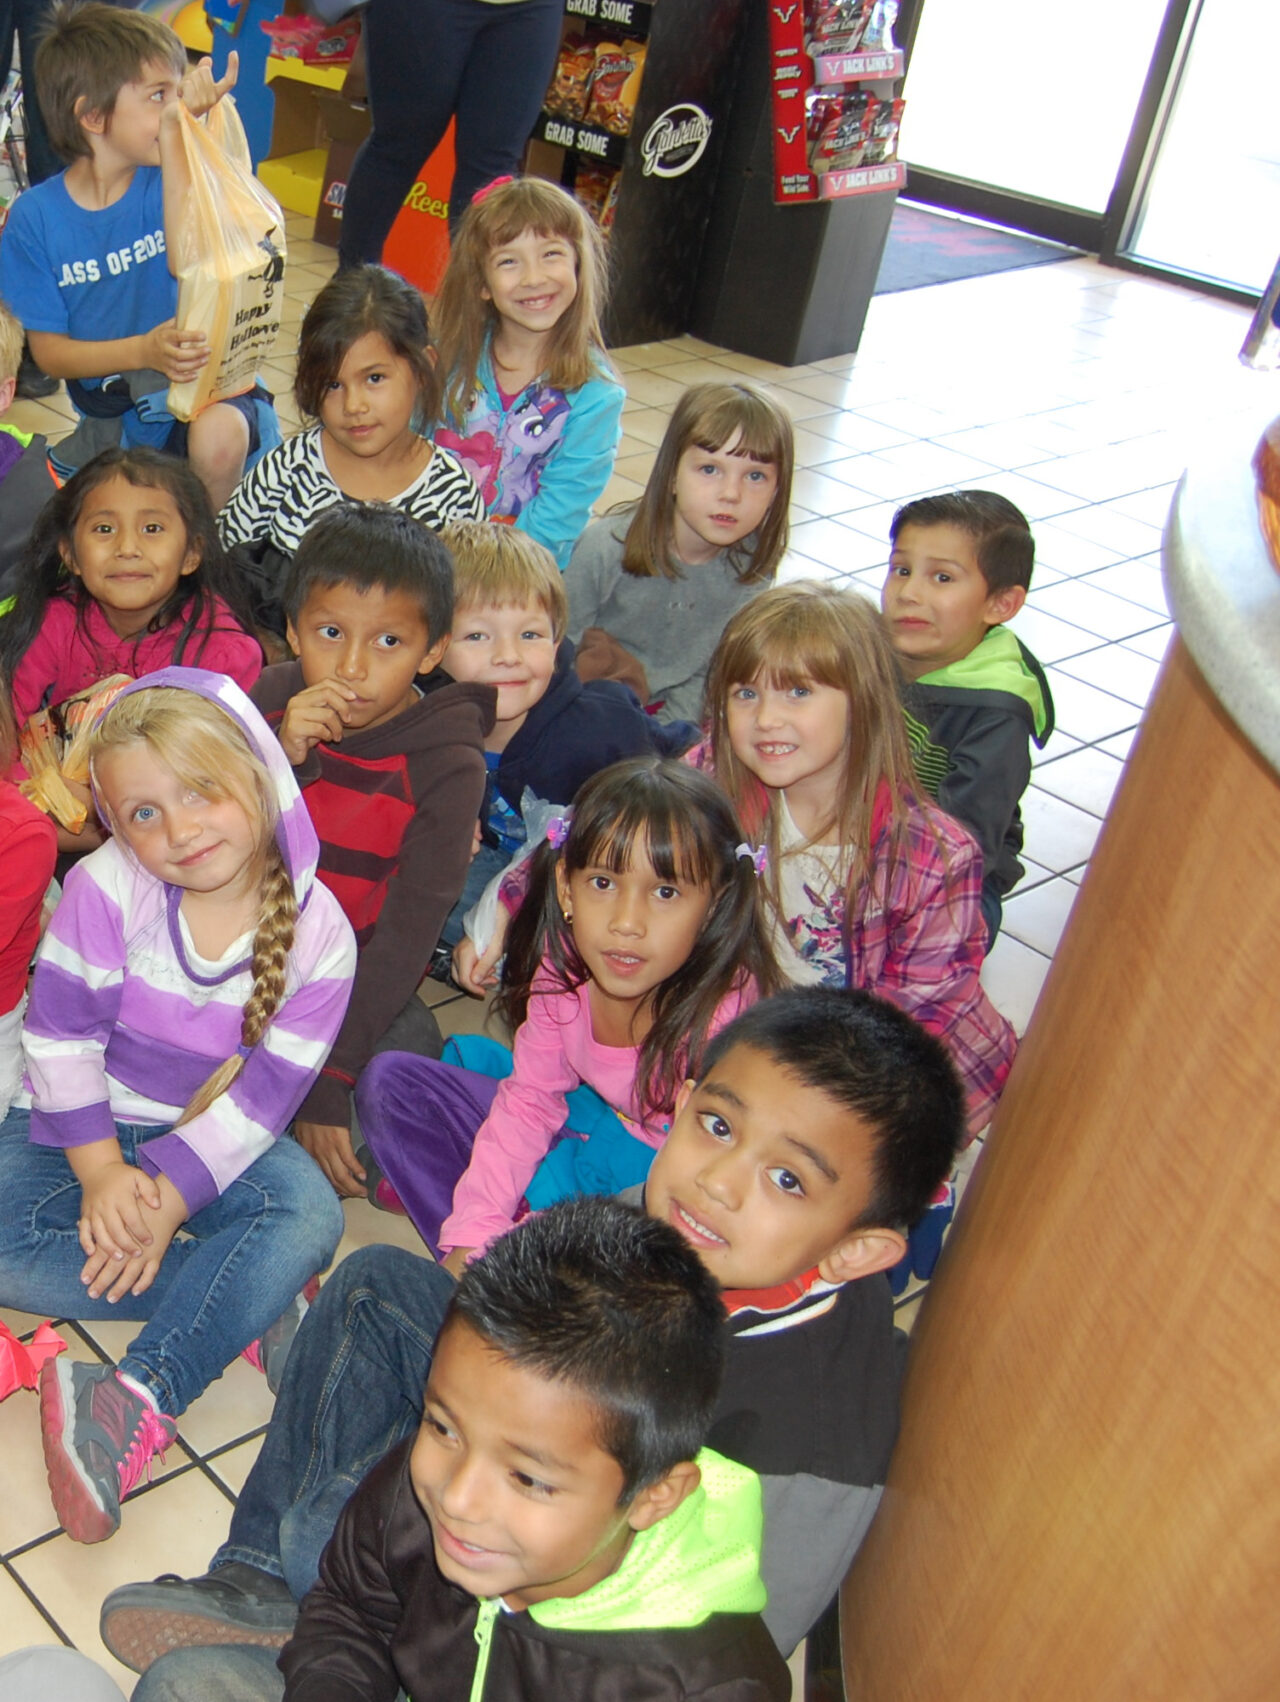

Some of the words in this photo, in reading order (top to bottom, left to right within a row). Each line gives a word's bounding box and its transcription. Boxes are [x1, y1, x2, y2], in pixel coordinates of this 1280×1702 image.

[600, 0, 634, 24] SOME
[843, 57, 865, 75] JACK
[865, 55, 895, 72] LINK'S
[544, 120, 575, 148] GRAB
[576, 130, 610, 157] SOME
[845, 171, 867, 189] JACK
[867, 168, 897, 187] LINK'S
[105, 246, 133, 276] OF
